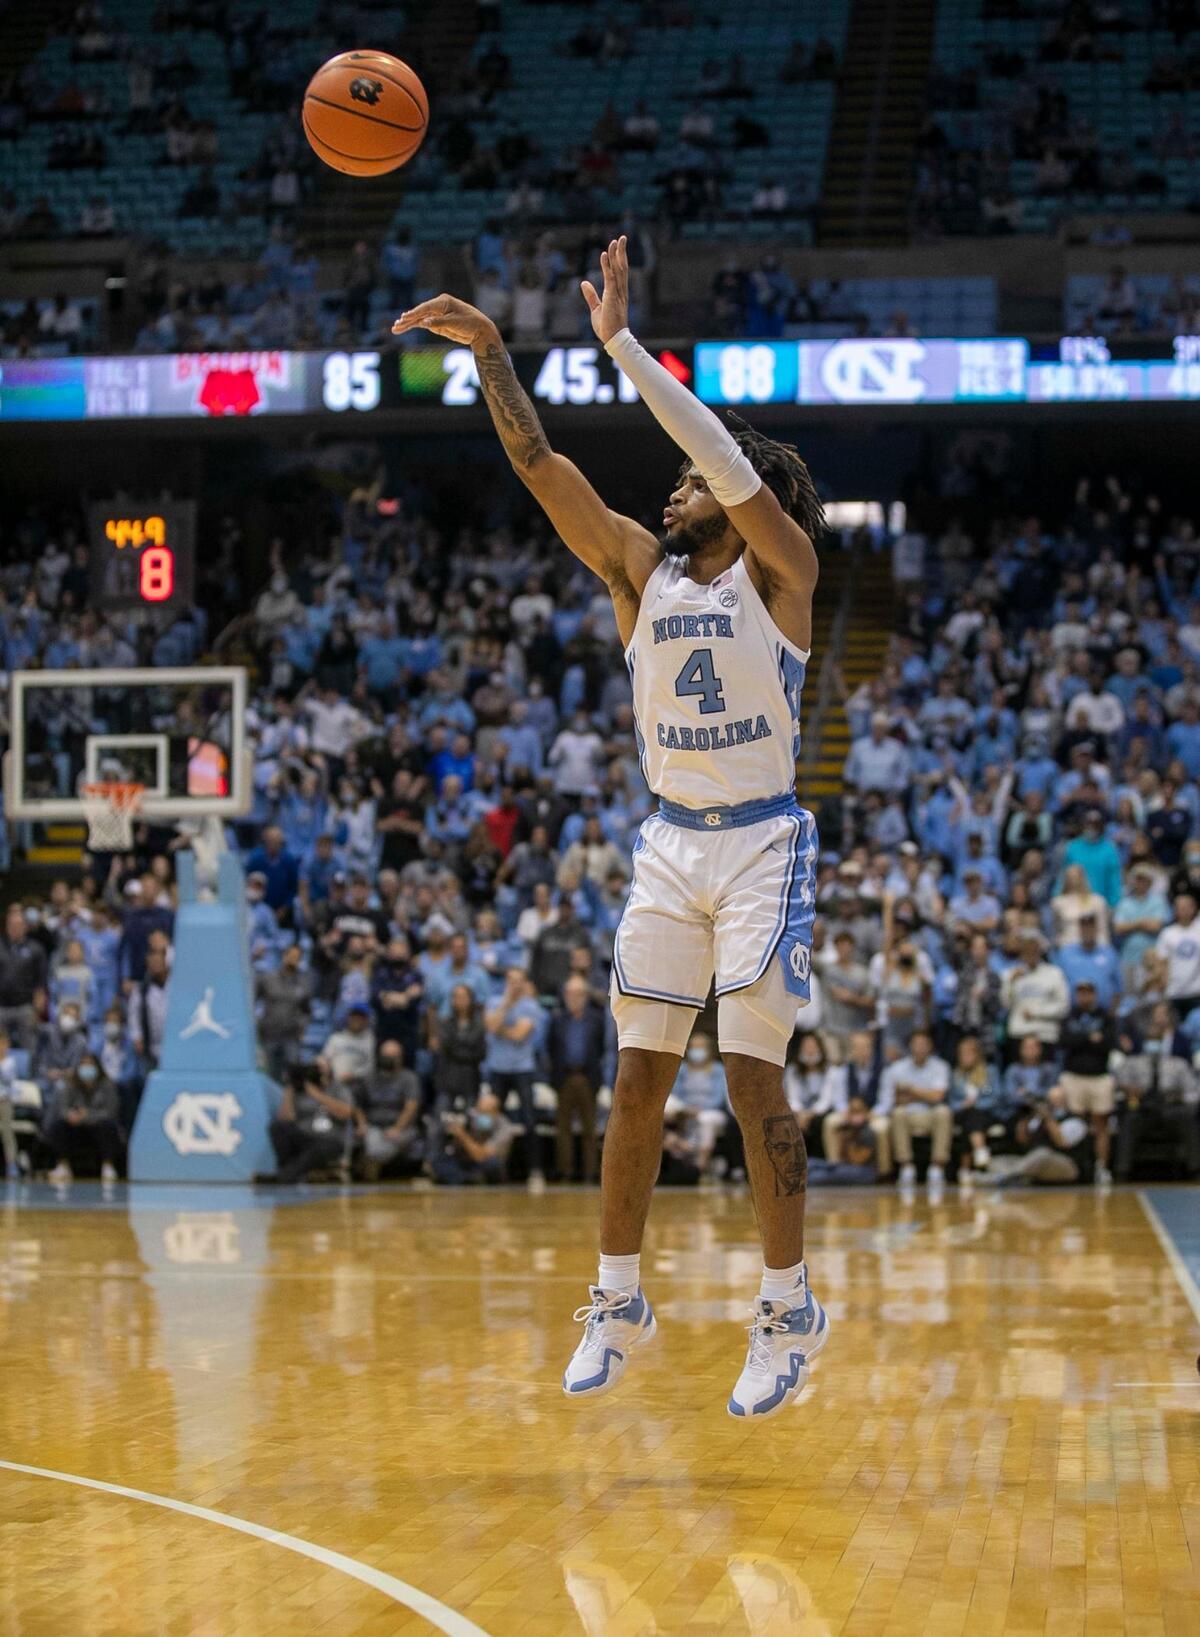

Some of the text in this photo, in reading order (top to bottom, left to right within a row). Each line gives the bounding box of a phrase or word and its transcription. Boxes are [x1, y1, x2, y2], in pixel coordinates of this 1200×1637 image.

[323, 351, 380, 411] 85
[720, 344, 776, 402] 88
[140, 546, 174, 602] 8
[652, 613, 735, 645] NORTH
[674, 648, 726, 715] 4
[657, 714, 772, 751] CAROLINA
